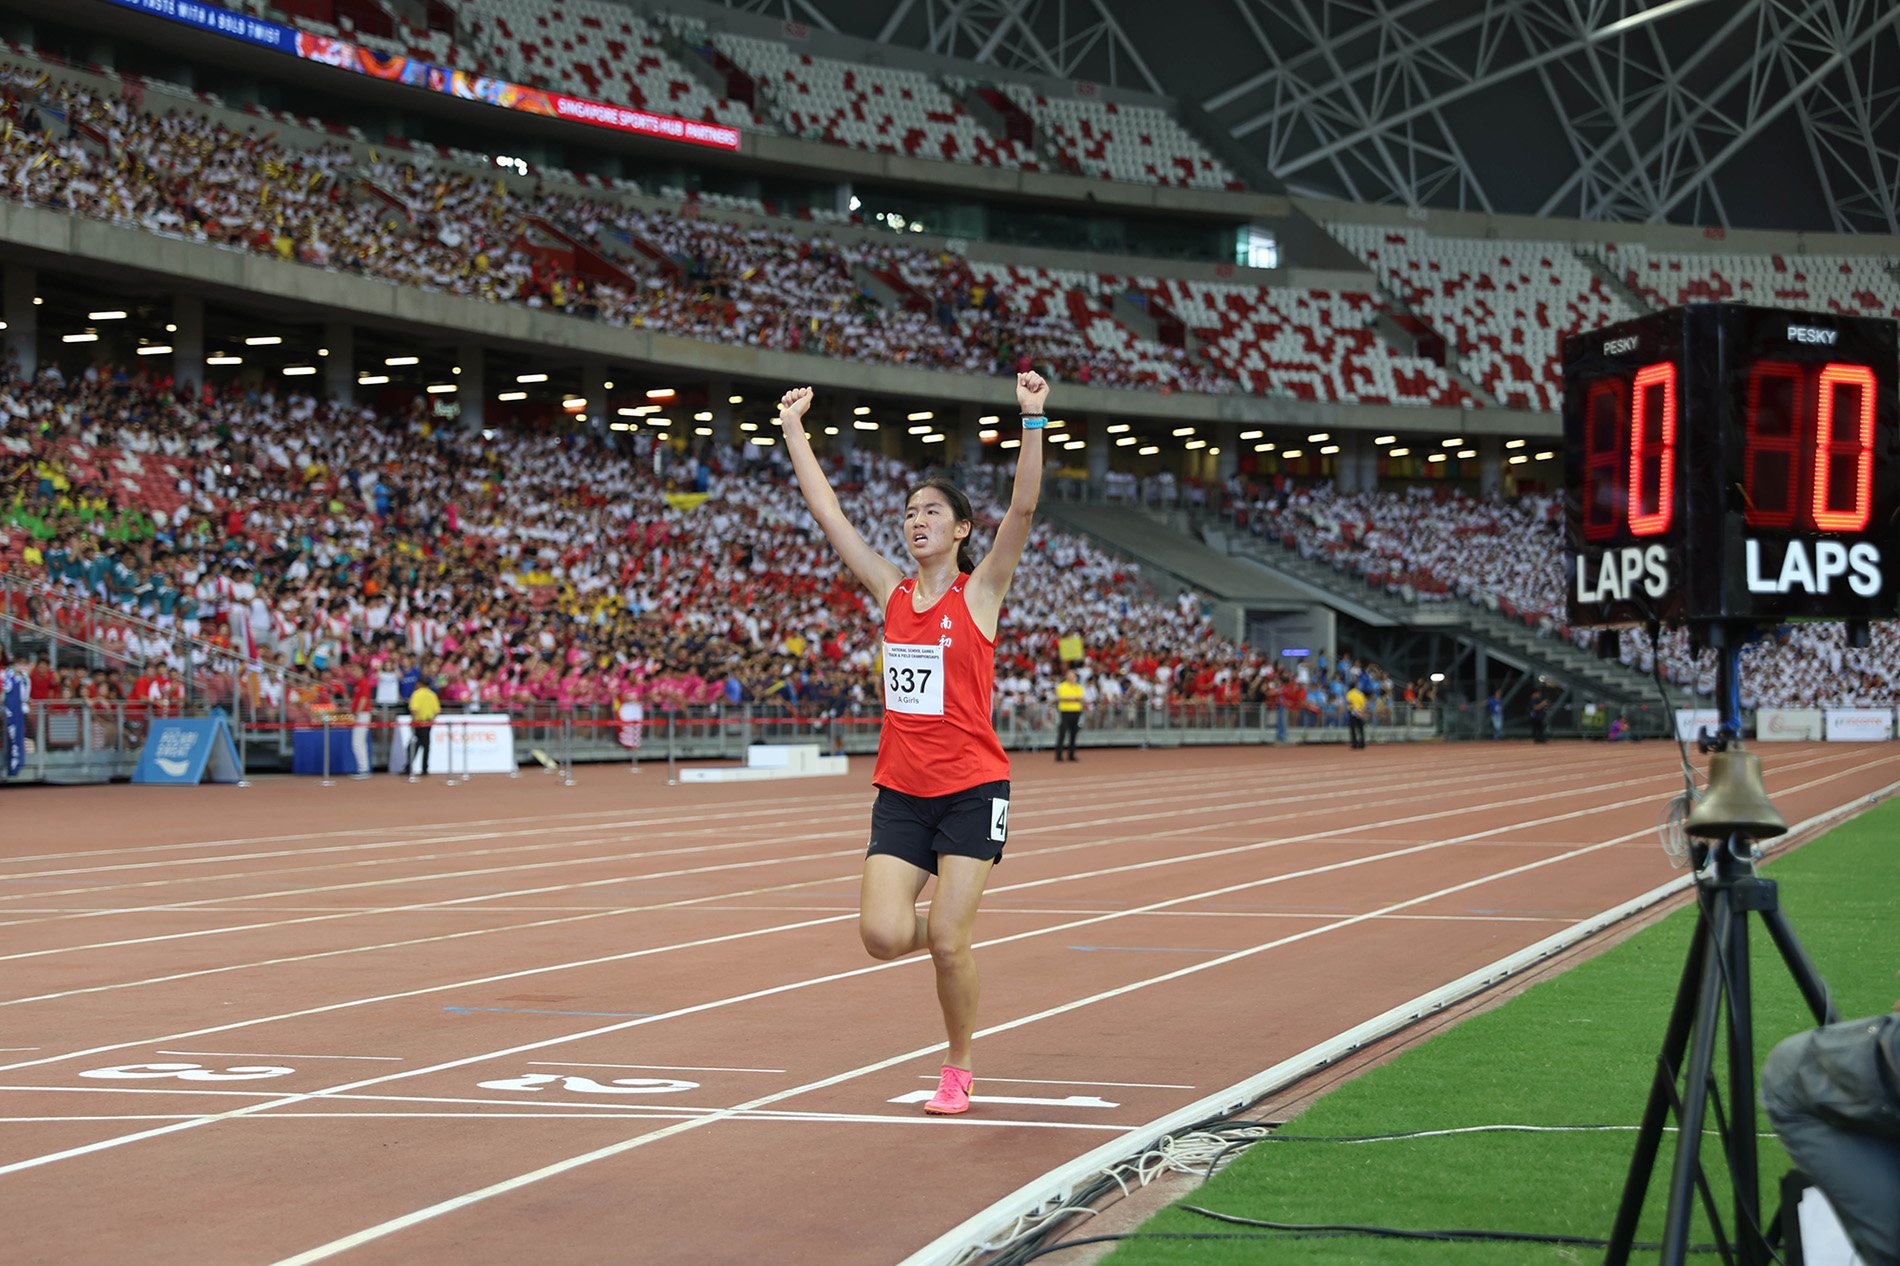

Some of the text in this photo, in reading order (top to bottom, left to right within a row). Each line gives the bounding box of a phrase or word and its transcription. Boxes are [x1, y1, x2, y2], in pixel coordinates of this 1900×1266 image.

[177, 3, 206, 23] WITH
[207, 11, 216, 26] A
[247, 21, 280, 45] TWIST
[557, 98, 738, 146] SINGAPORE SPORTS HUB PARTNERS
[1602, 336, 1640, 356] PESKY
[1787, 326, 1837, 345] PESKY
[1576, 544, 1669, 603] LAPS
[1745, 538, 1883, 597] LAPS
[889, 667, 932, 693] 337
[903, 696, 919, 704] Girls
[995, 806, 1005, 835] 4
